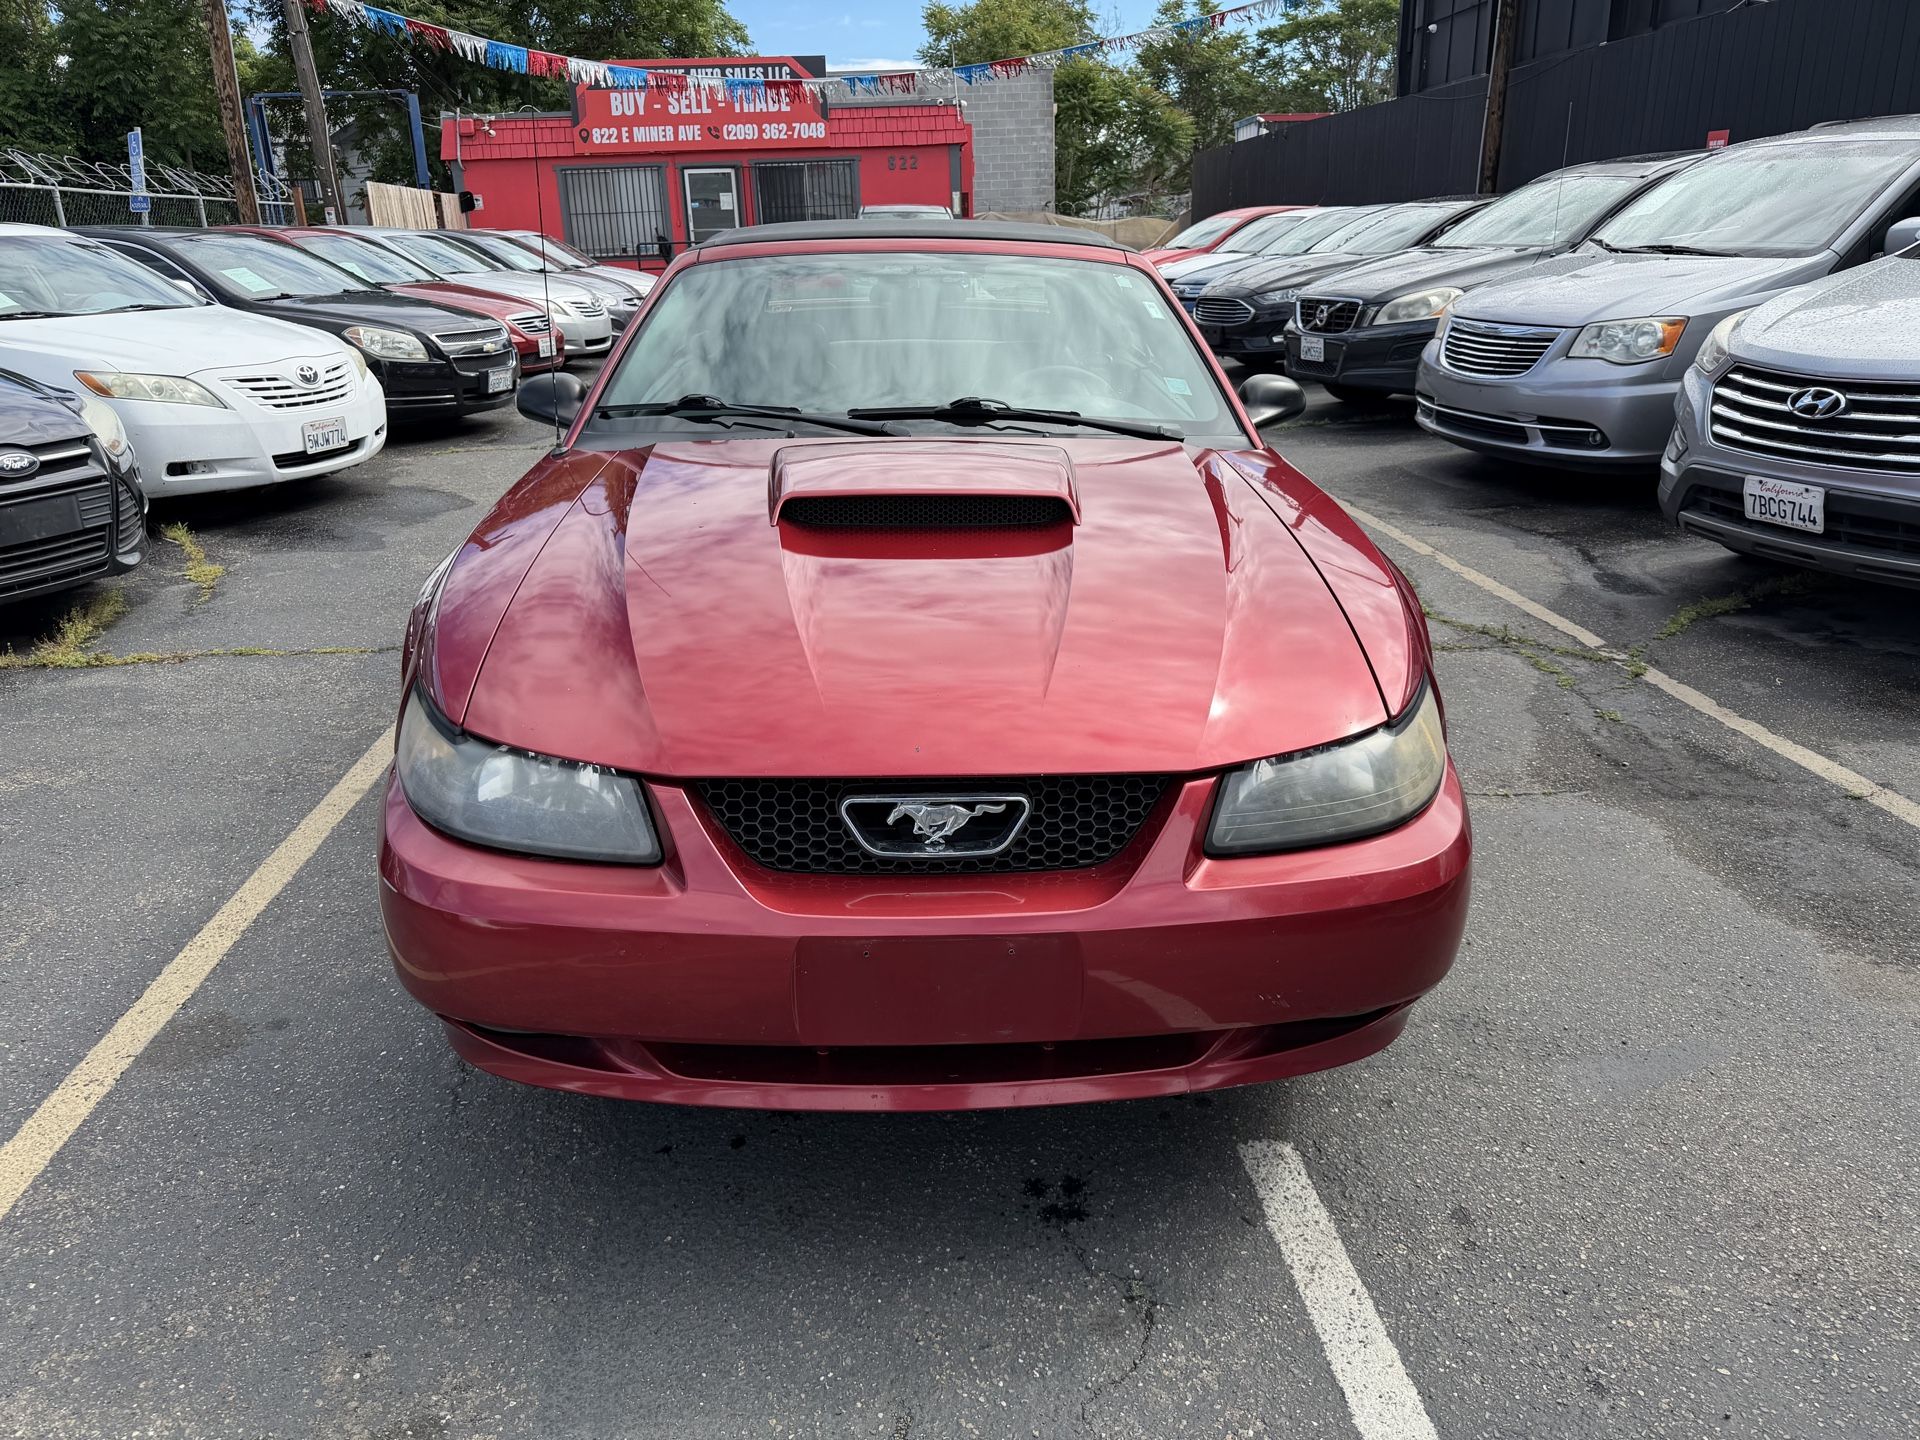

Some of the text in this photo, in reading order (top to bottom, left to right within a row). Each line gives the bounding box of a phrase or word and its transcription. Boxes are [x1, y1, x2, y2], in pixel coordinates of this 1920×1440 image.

[725, 67, 764, 79] SALES
[768, 66, 790, 80] LLC
[610, 92, 646, 116] BUY
[668, 91, 712, 115] SELL
[592, 125, 701, 144] 822 E MINER AVE
[723, 122, 826, 141] (209) 362-7048
[888, 154, 918, 170] 822
[307, 429, 346, 449] 5WJW774
[3, 457, 30, 470] Ford
[1759, 481, 1807, 499] California
[1748, 493, 1818, 526] 7BCG744
